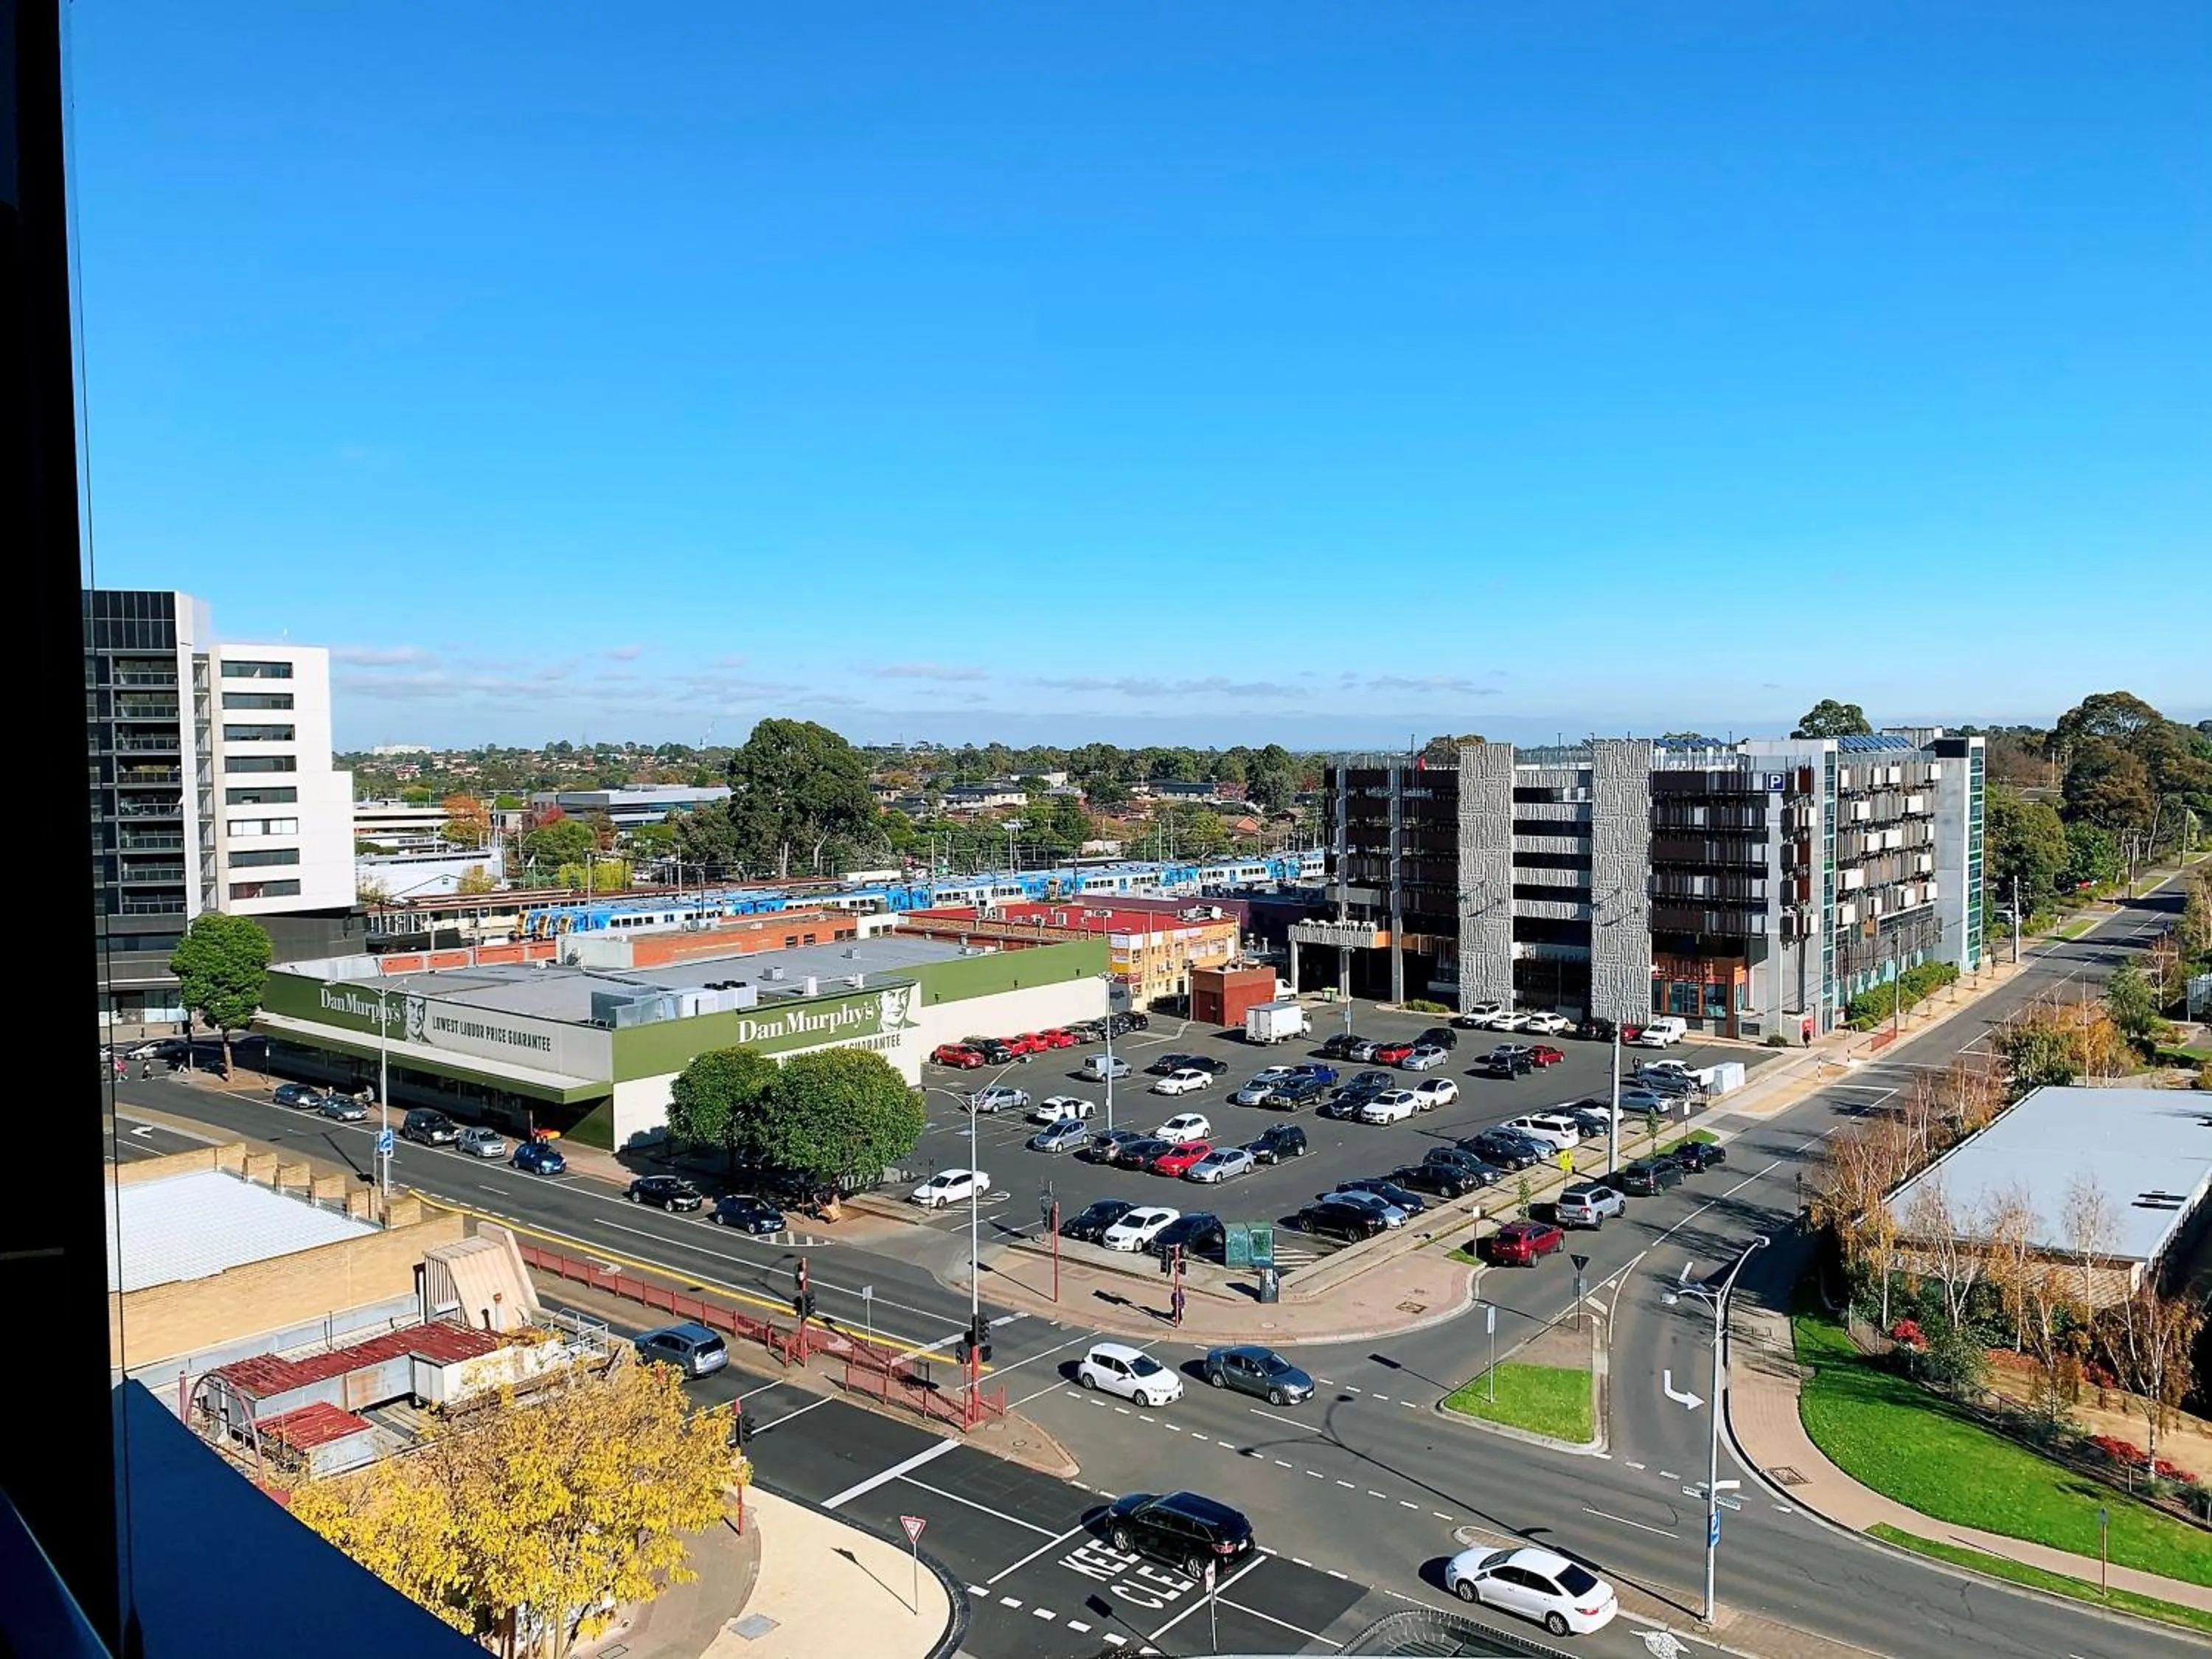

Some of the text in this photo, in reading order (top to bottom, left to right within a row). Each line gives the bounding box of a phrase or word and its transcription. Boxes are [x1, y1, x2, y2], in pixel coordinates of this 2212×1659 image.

[1770, 775, 1781, 788] P
[320, 987, 401, 1027] Dan Murphy's
[737, 1001, 874, 1043] Dan Murphy's
[432, 1015, 552, 1052] LOWEST LIQUOR PRICE GUARANTEE
[1057, 1538, 1142, 1582] KEE
[1110, 1564, 1200, 1609] CLE
